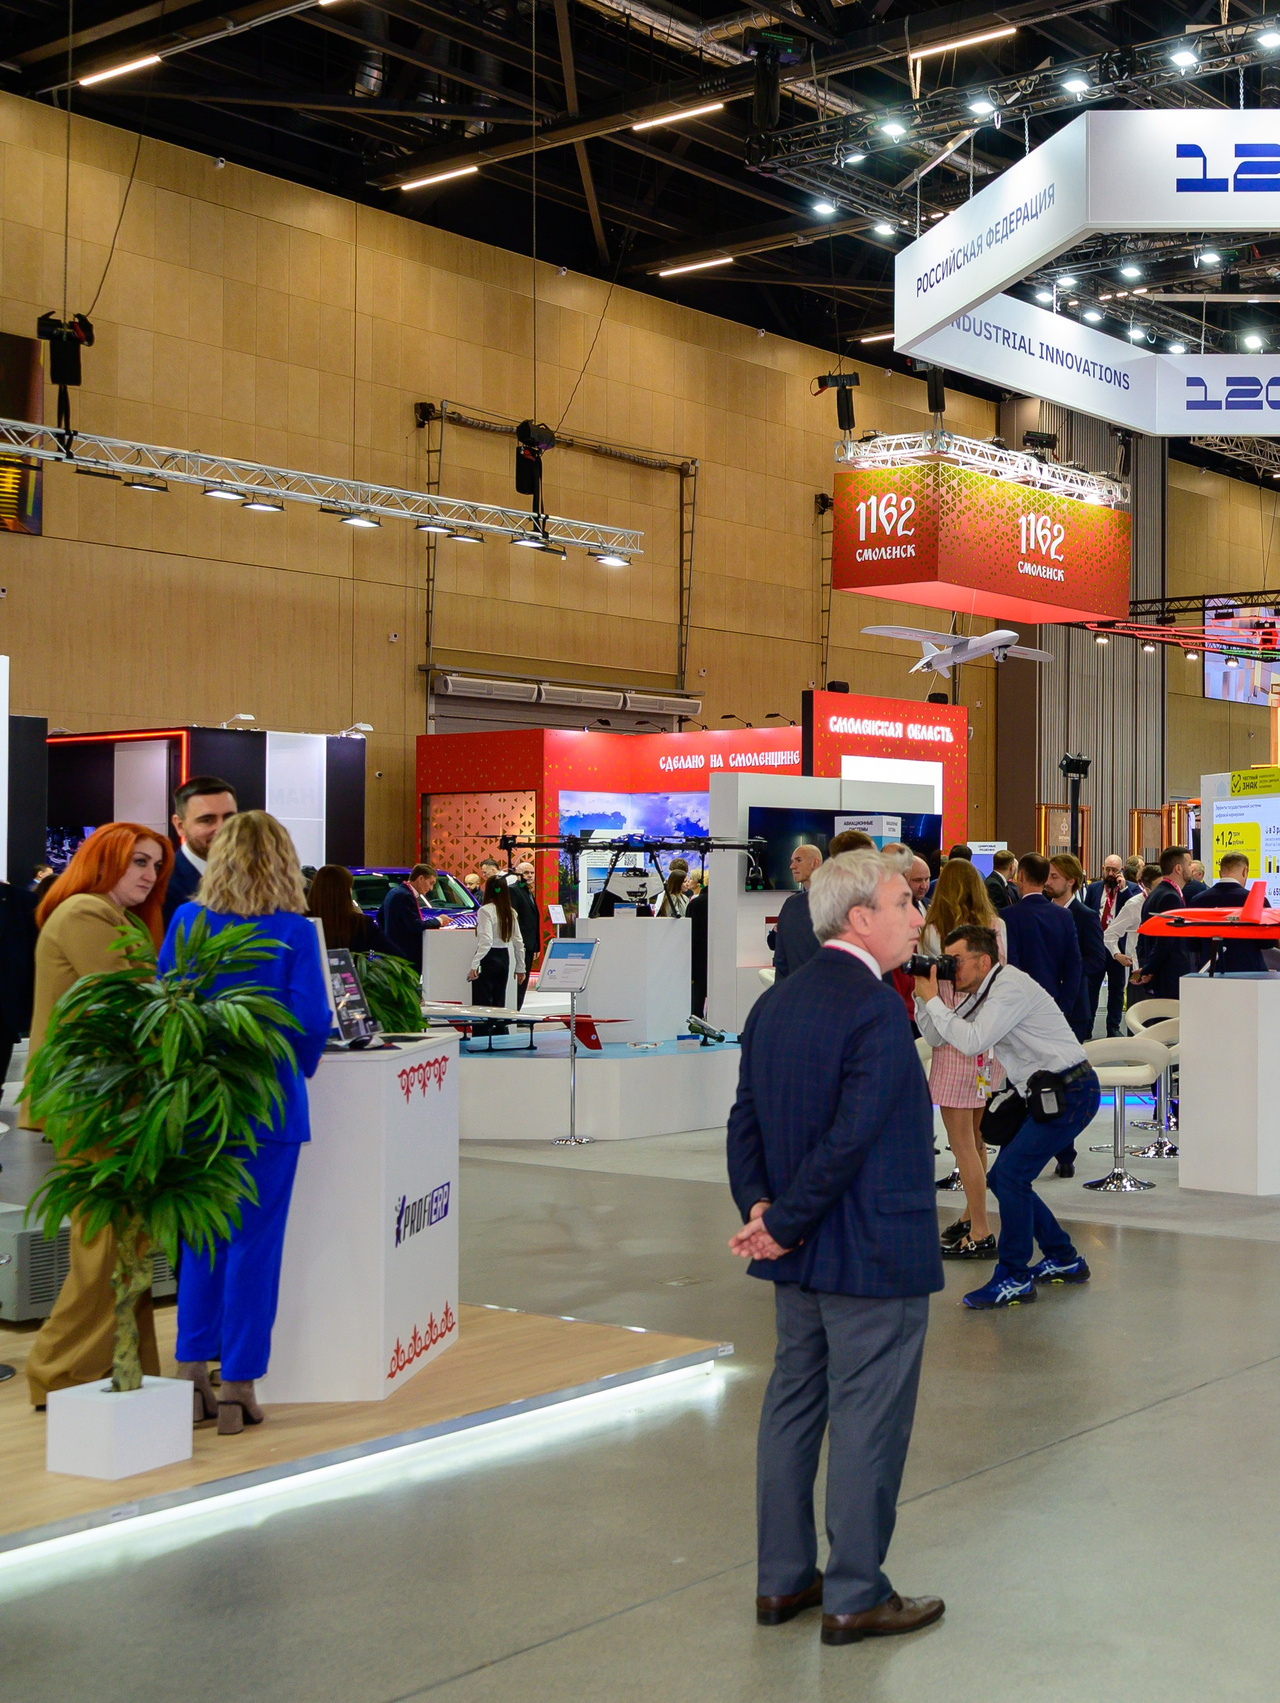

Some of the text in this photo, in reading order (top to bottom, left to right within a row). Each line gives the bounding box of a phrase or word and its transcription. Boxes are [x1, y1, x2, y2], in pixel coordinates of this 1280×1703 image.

[916, 182, 1055, 298] РОССИЙСКАЯ ФЕДЕРАЦИЯ
[950, 313, 1130, 390] NDUSTRIAL INNOVATIONS
[855, 492, 916, 541] 1162
[1018, 511, 1065, 562] 1162
[855, 544, 916, 562] СМОЛЕНСК
[1017, 560, 1065, 582] СМОЛЕНСК
[829, 715, 954, 743] СМОЛЕНСКАЯ ОБЛАСТЬ
[659, 750, 800, 772] СДЕЛАНО НА СМОЛЕНЩИНЕ
[1242, 781, 1258, 790] ЗНАК
